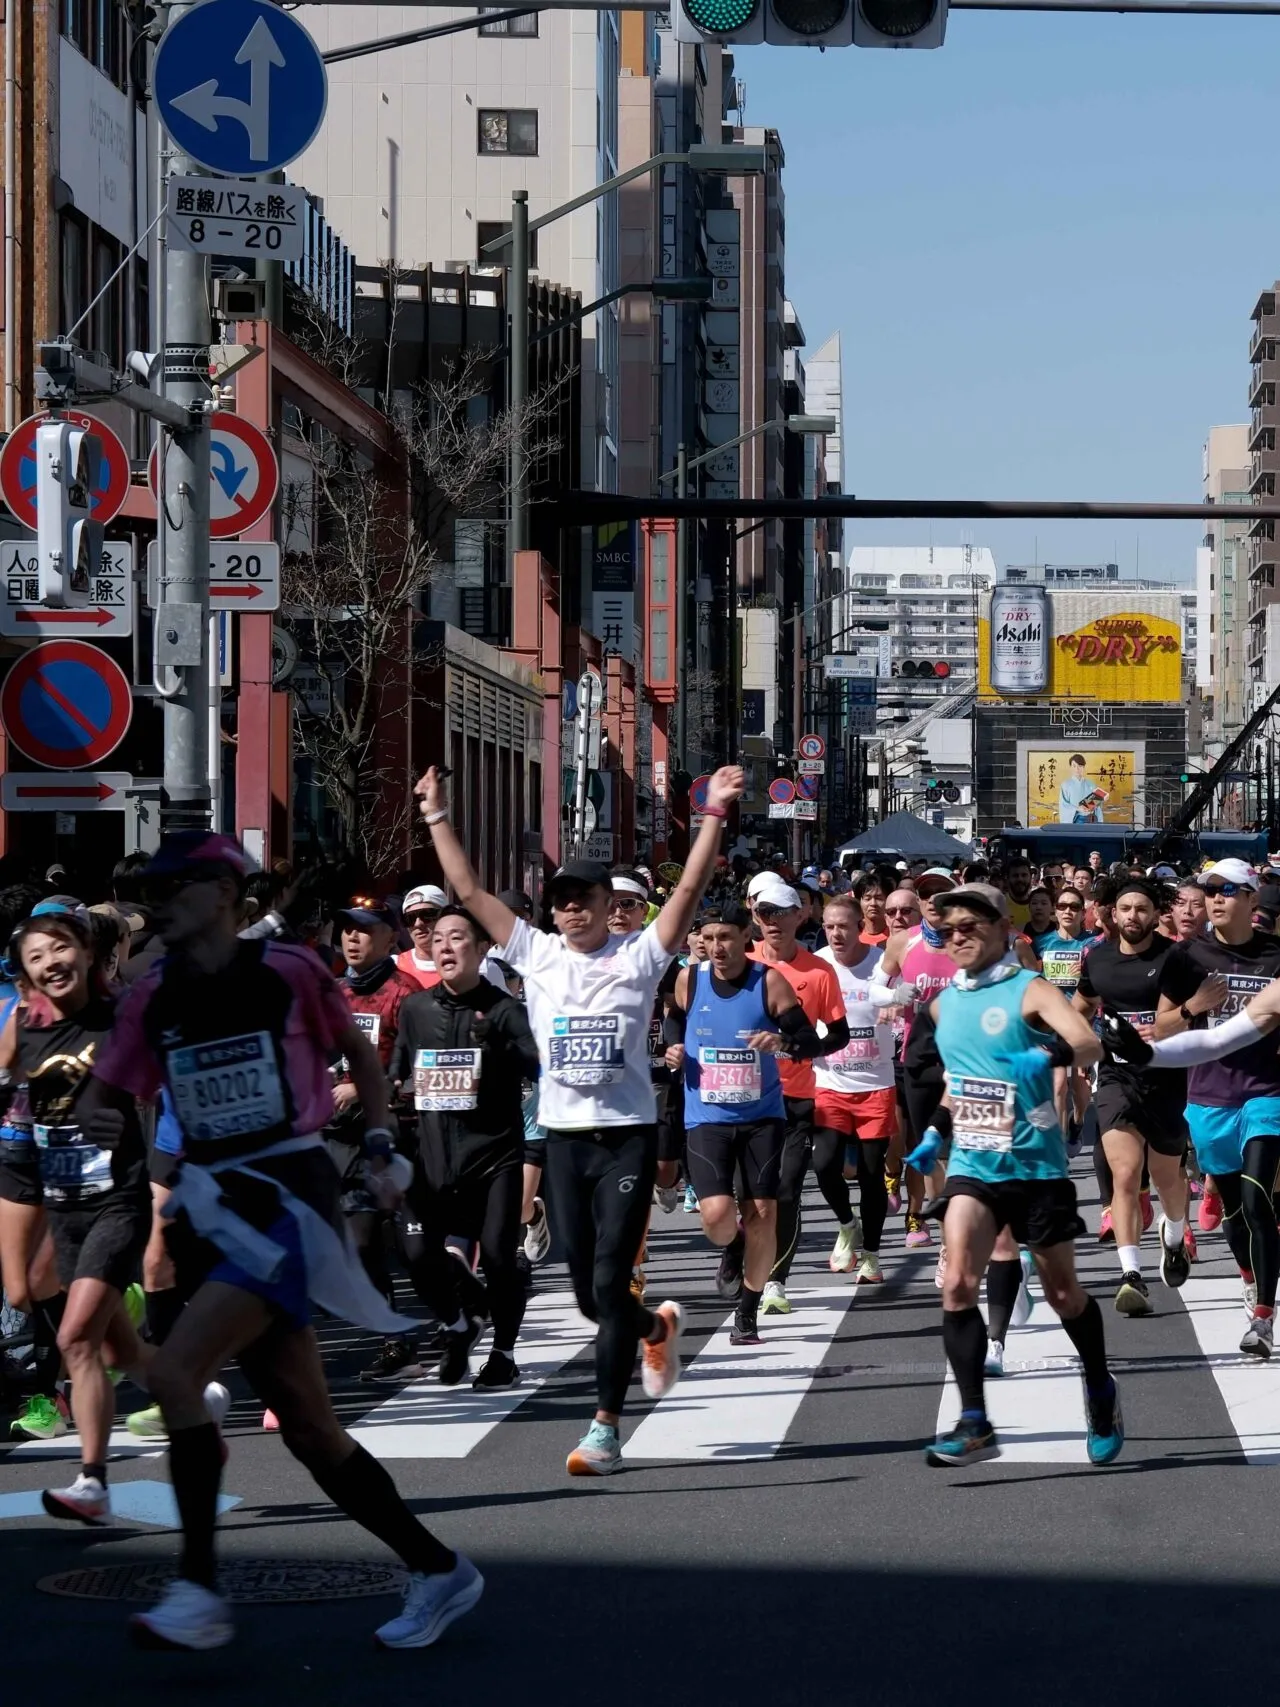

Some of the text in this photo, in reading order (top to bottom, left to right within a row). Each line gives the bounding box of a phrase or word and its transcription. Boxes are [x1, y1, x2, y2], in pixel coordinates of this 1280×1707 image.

[175, 188, 297, 221] 路線バスを除く
[595, 552, 631, 564] SMBC
[995, 622, 1042, 642] Asahi
[1093, 619, 1144, 632] SUPER
[1013, 645, 1025, 655] 生
[1053, 707, 1107, 723] FRONT
[1230, 979, 1268, 990] 東京メトロ
[570, 1020, 616, 1030] 東京メトロ
[198, 1042, 259, 1065] 東京メトロ
[562, 1037, 611, 1062] 35521
[718, 1052, 753, 1061] 東京メトロ
[436, 1054, 473, 1063] 東京メトロ
[428, 1069, 472, 1091] 23378
[711, 1067, 752, 1085] 75676
[192, 1068, 265, 1109] 80202
[963, 1083, 1006, 1097] 東京メトロ
